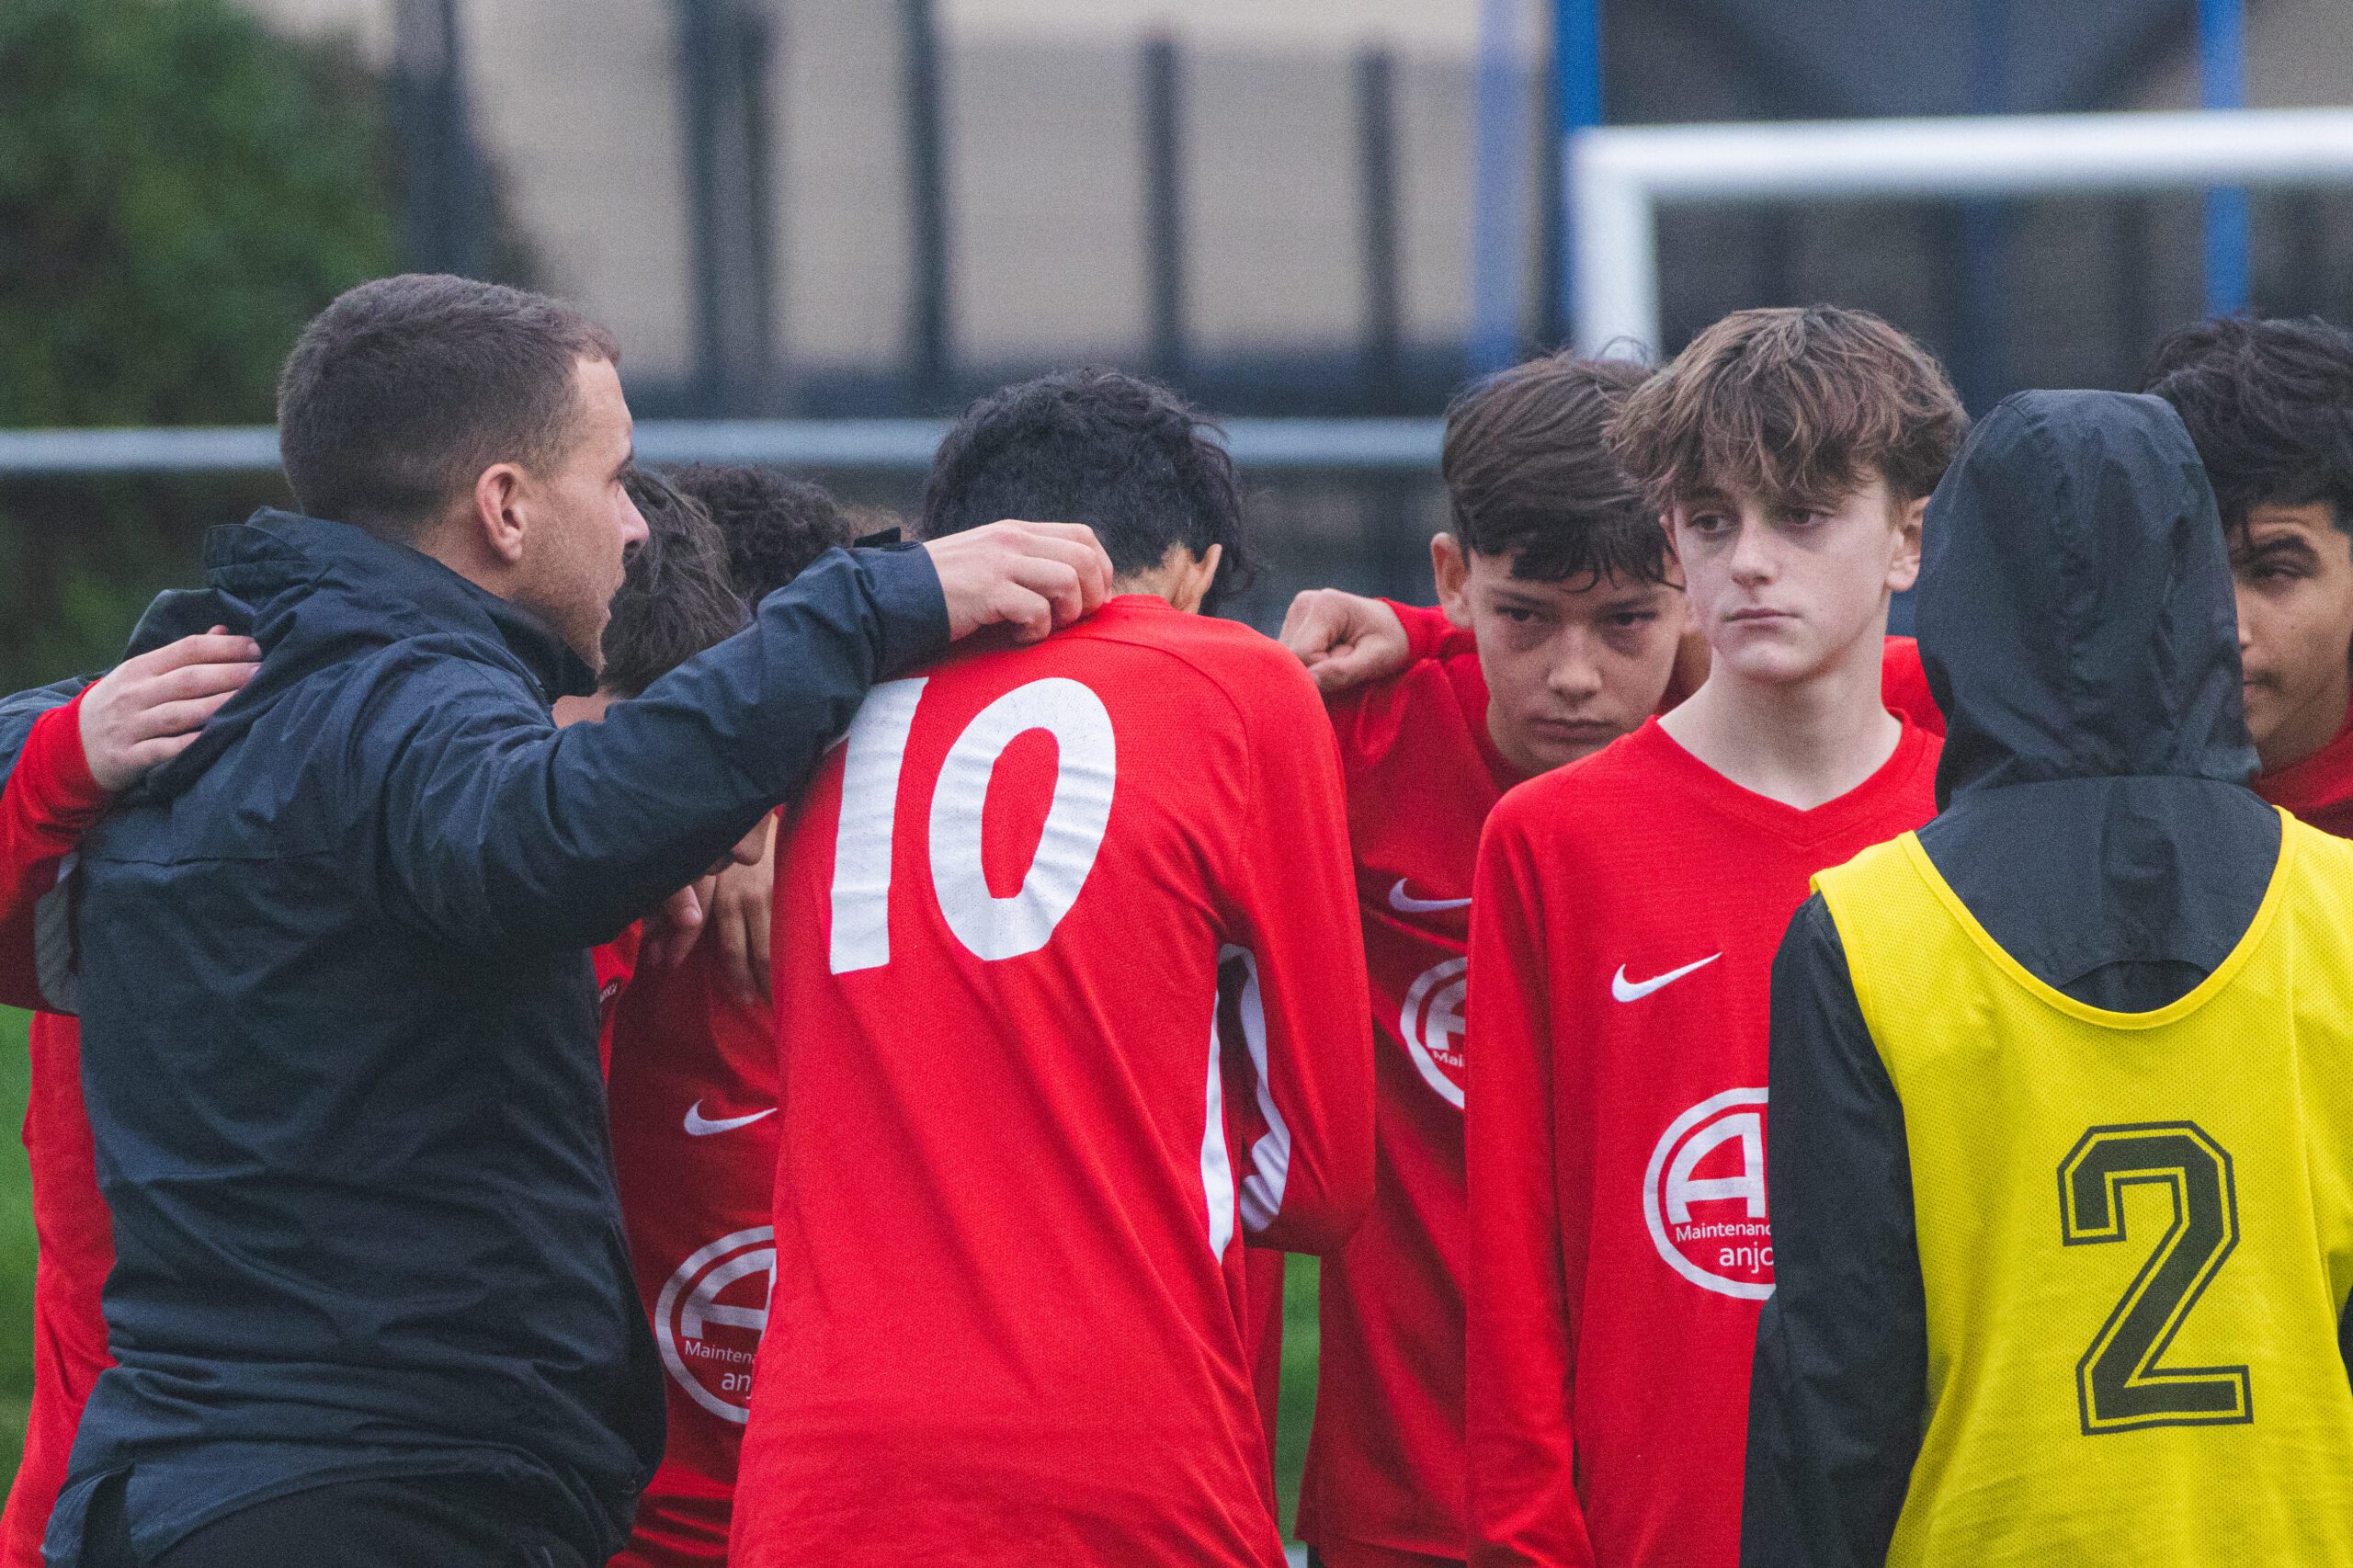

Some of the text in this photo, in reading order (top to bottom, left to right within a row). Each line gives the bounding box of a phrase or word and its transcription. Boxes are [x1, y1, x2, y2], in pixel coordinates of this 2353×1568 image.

[829, 676, 1116, 975] 10
[1665, 1112, 1766, 1224] A
[2056, 1119, 2254, 1437] 2
